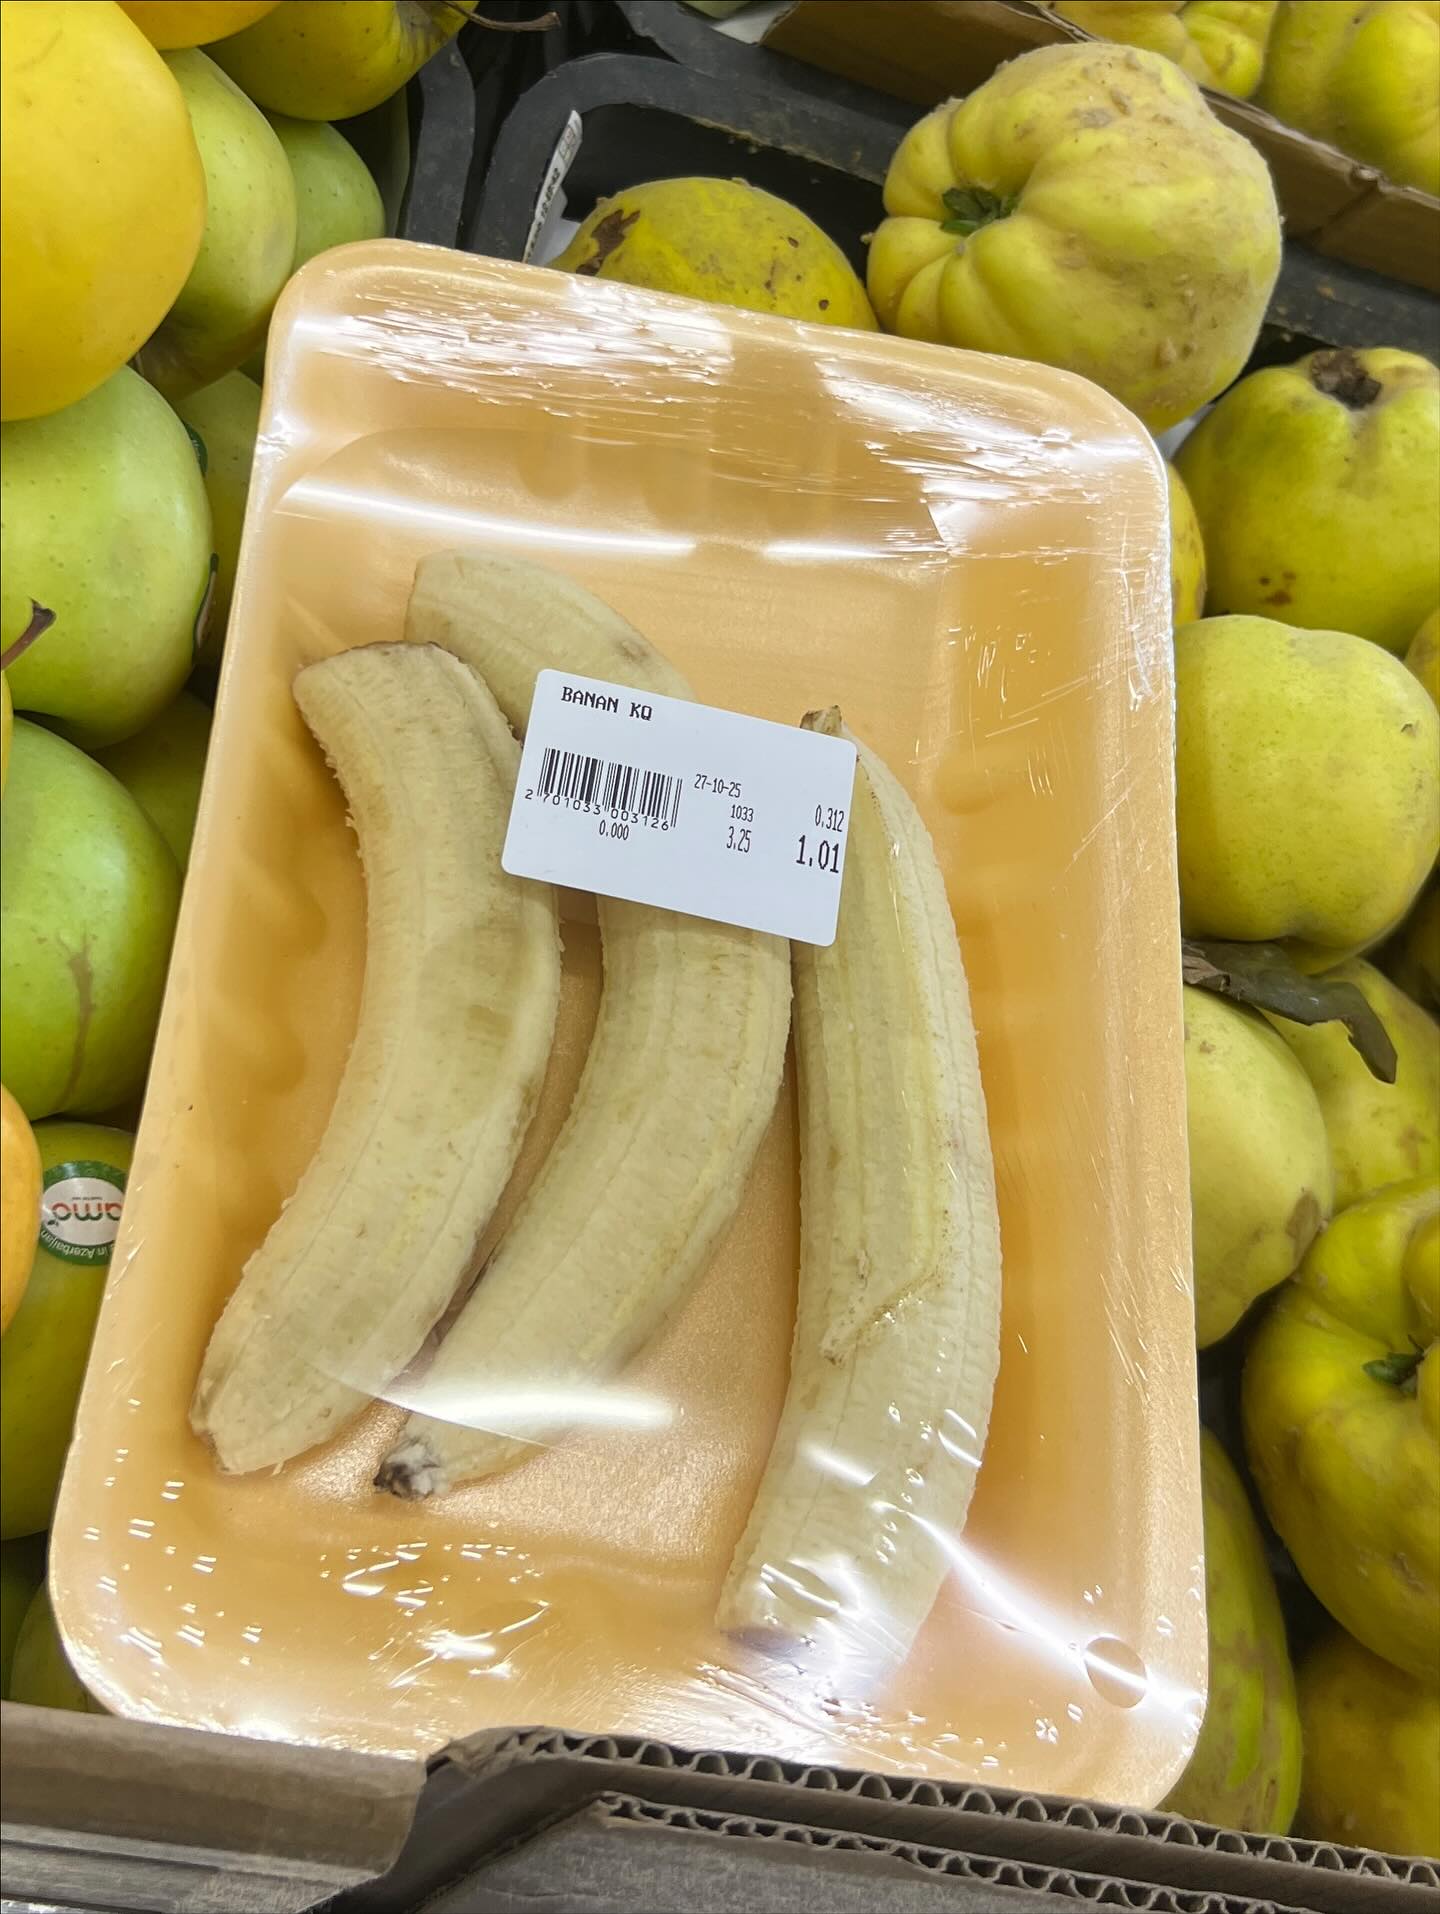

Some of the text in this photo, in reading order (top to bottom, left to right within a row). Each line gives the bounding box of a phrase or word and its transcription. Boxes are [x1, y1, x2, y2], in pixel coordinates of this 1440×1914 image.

[561, 686, 652, 721] BANAN KQ
[694, 773, 741, 798] 27-10-25
[730, 804, 754, 822] 1033
[815, 804, 844, 832] 0.312
[599, 819, 629, 840] 0.000
[726, 826, 752, 853] 3.25
[796, 834, 840, 873] 1.01
